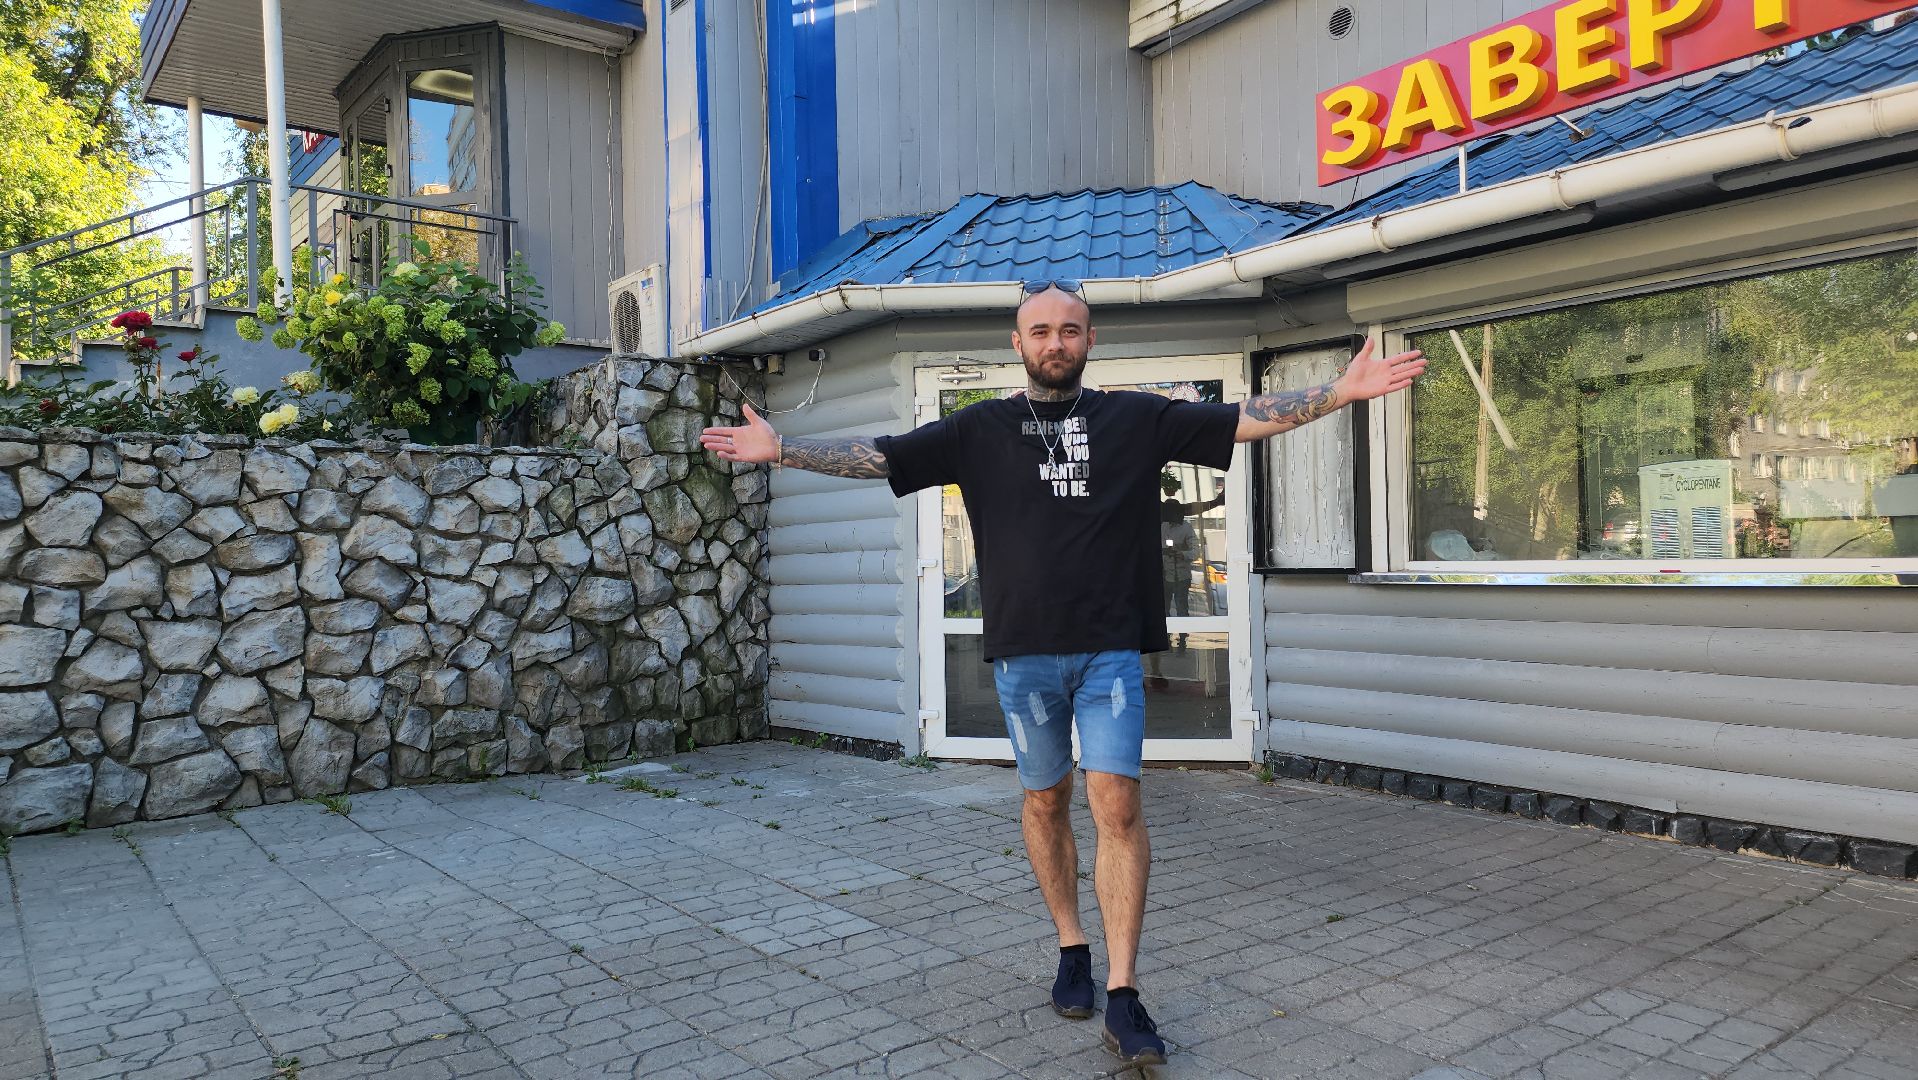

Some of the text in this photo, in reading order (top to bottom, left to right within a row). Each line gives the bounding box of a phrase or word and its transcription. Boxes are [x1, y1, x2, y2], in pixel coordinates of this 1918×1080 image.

[1322, 0, 1790, 167] ЗАВЕР
[1021, 416, 1087, 436] REMEMBER
[1061, 433, 1088, 447] WHO
[1064, 445, 1090, 462] YOU
[1038, 462, 1090, 481] WANTED
[1051, 480, 1090, 497] TO BE.
[1675, 477, 1721, 492] CYCLOPENTANE
